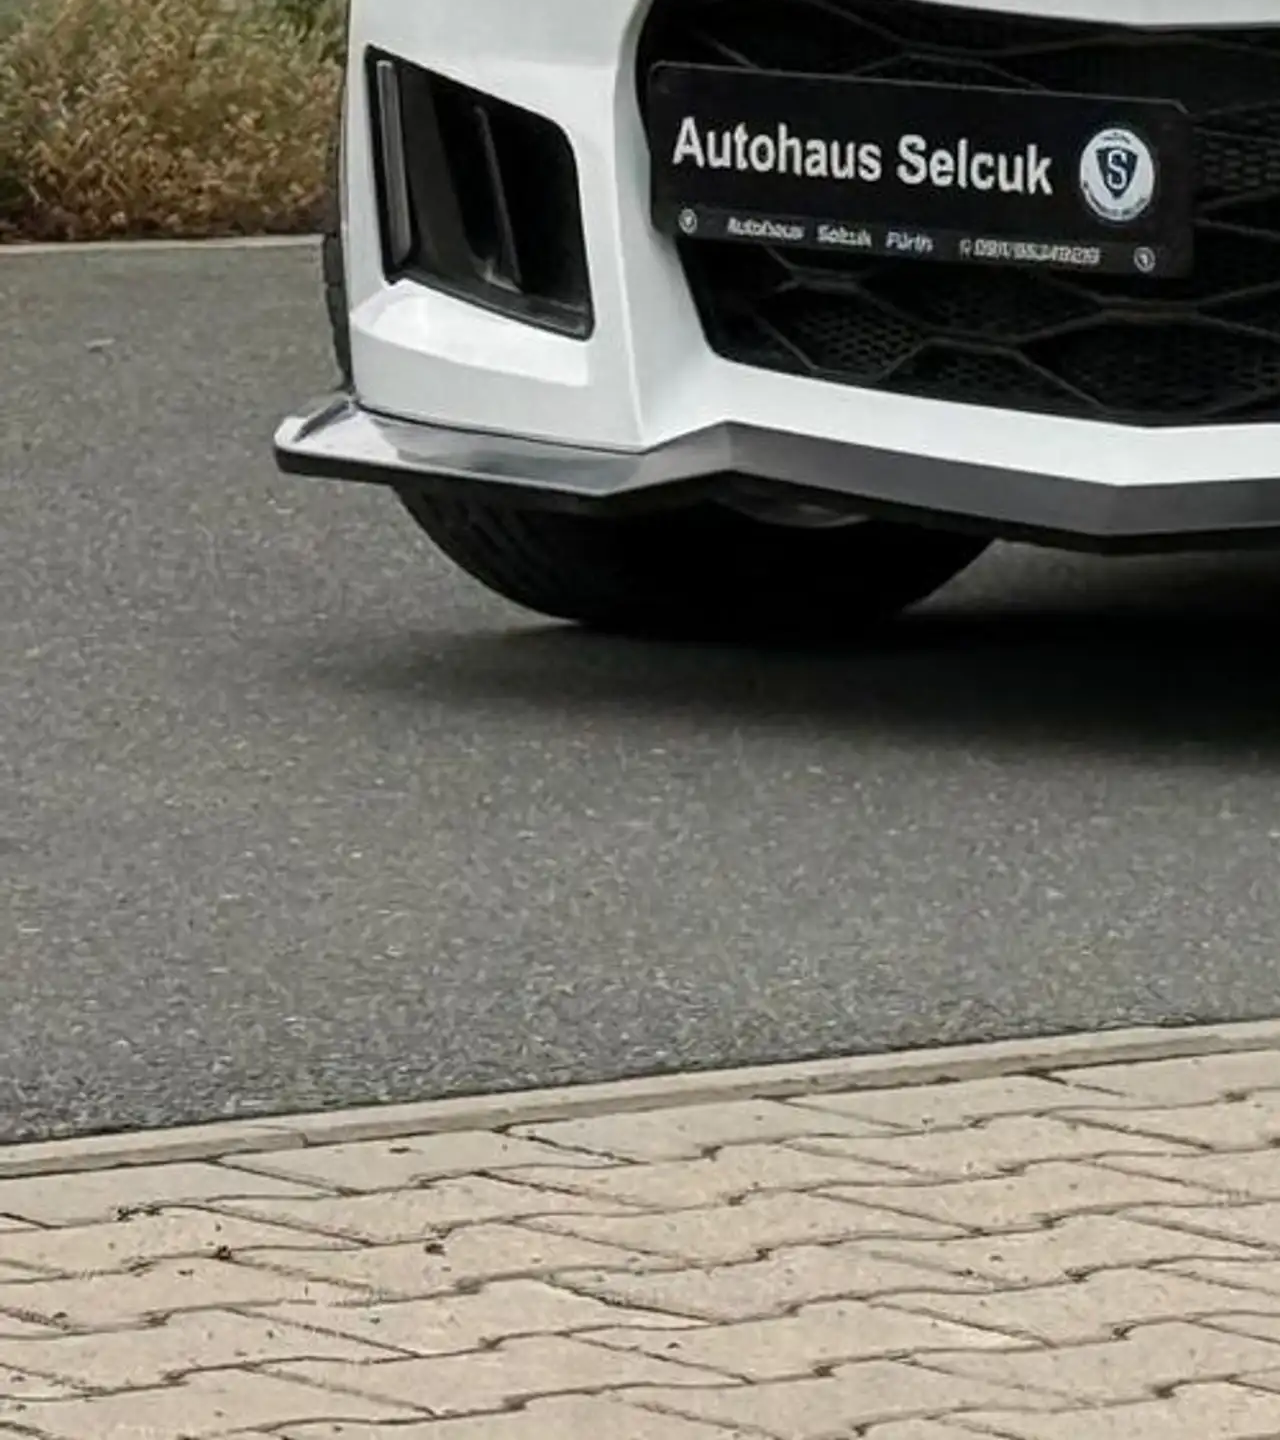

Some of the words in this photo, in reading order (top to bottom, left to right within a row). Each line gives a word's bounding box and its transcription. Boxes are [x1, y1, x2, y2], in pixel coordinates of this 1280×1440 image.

[672, 116, 882, 182] Autohaus
[897, 134, 1053, 195] Selcuk
[1107, 149, 1128, 190] S
